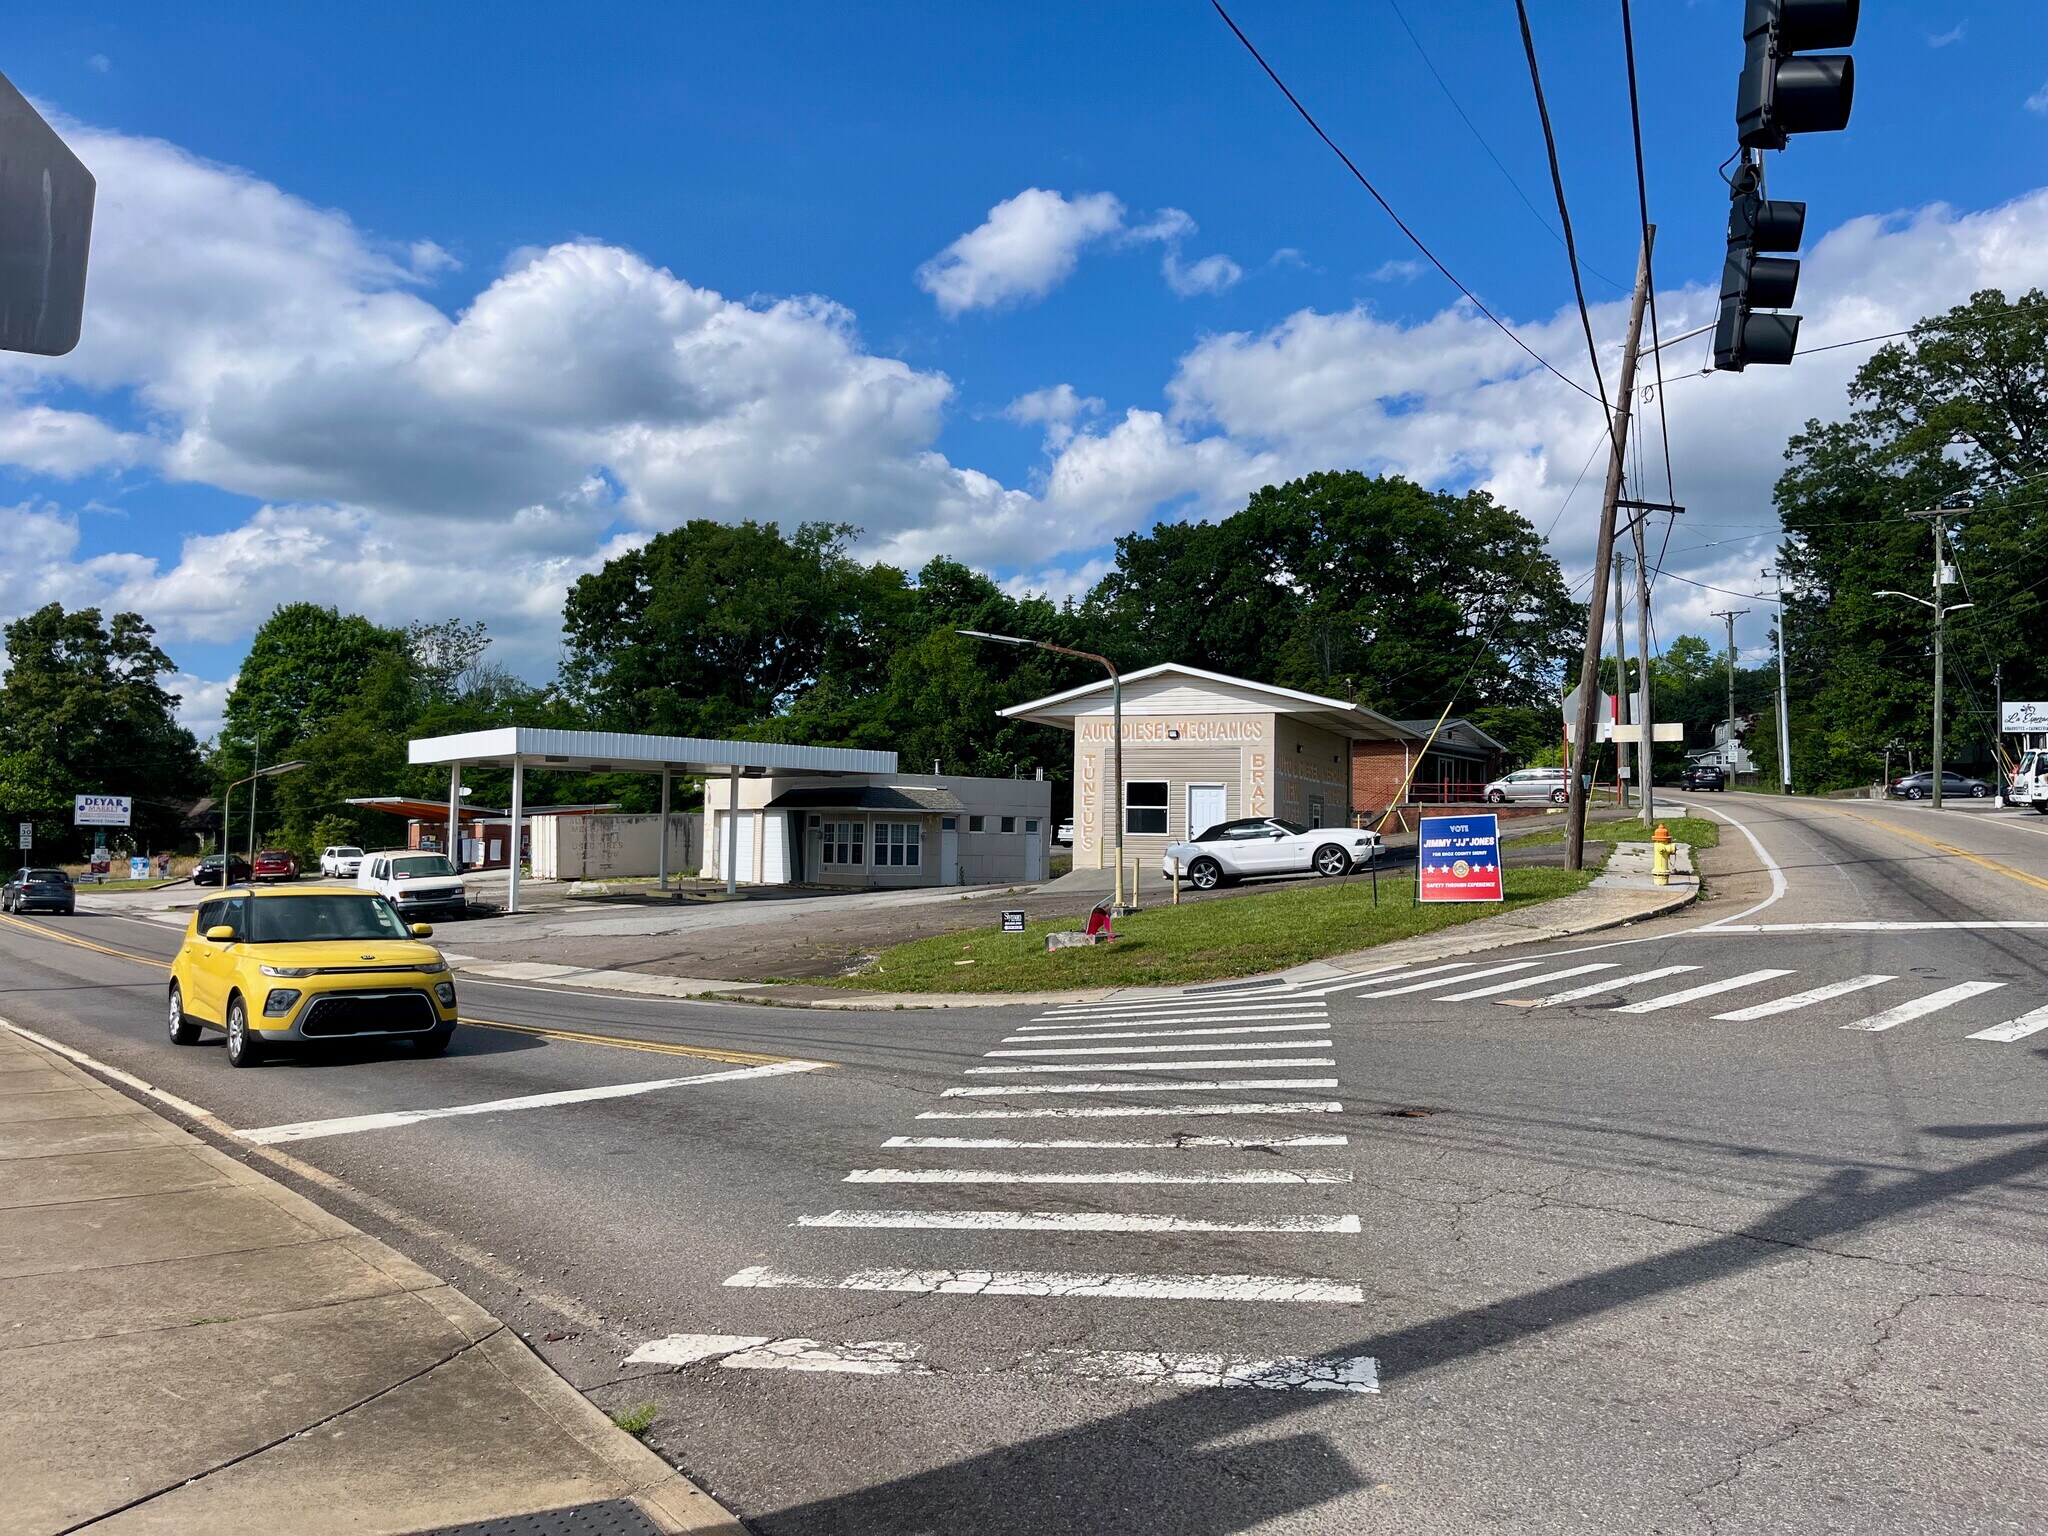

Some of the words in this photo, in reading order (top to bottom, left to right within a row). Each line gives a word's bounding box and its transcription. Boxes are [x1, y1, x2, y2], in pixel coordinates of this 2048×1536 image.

[1174, 721, 1264, 742] MECHANICS
[85, 798, 123, 807] DEYAR
[1449, 825, 1469, 833] VOTE
[1424, 838, 1452, 848] JIMMY
[1469, 837, 1495, 846] JONES
